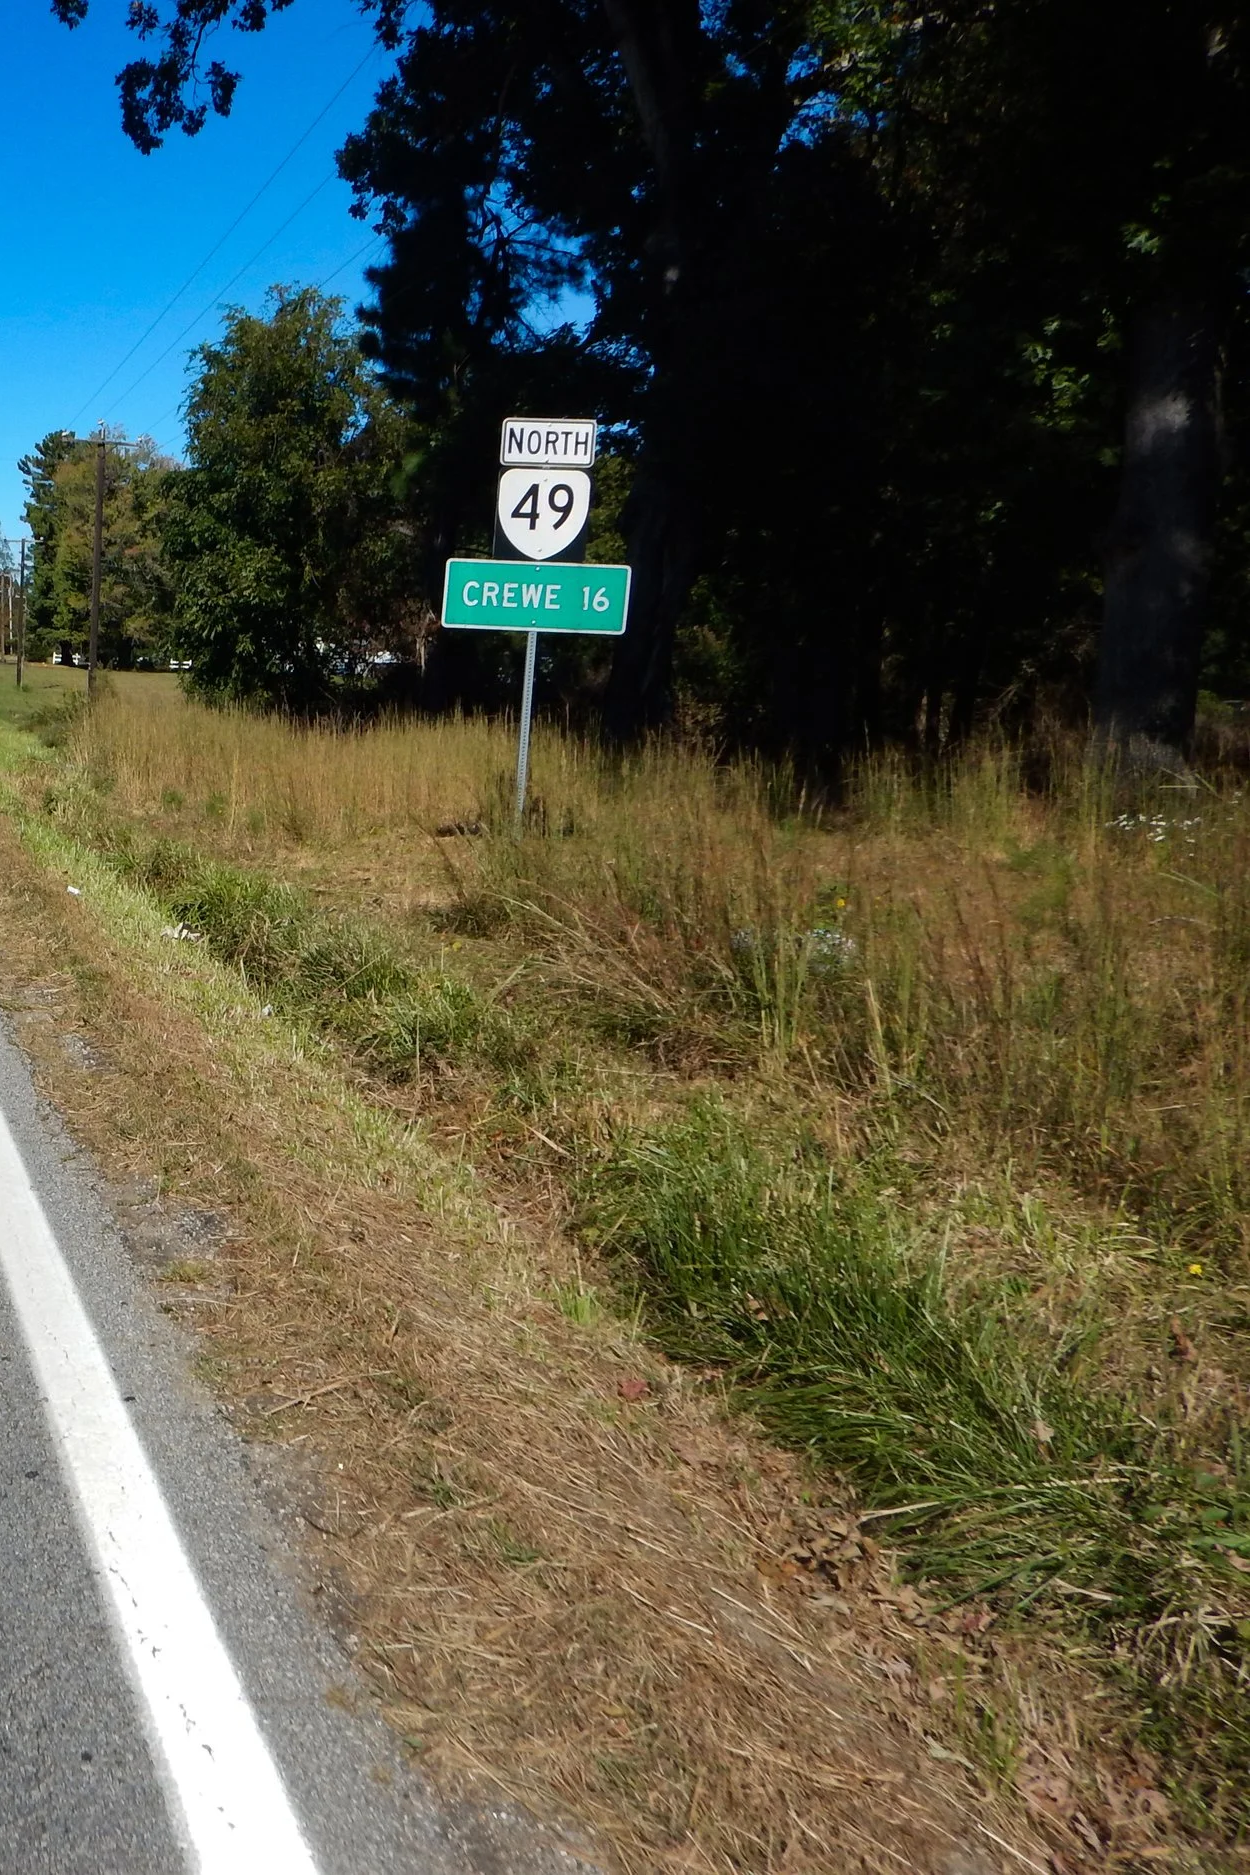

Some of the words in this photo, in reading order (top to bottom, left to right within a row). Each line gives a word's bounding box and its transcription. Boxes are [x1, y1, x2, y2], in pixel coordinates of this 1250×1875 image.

[508, 428, 589, 456] NORTH
[511, 484, 575, 531] 49
[462, 581, 562, 610] CREWE
[582, 586, 610, 612] 16
